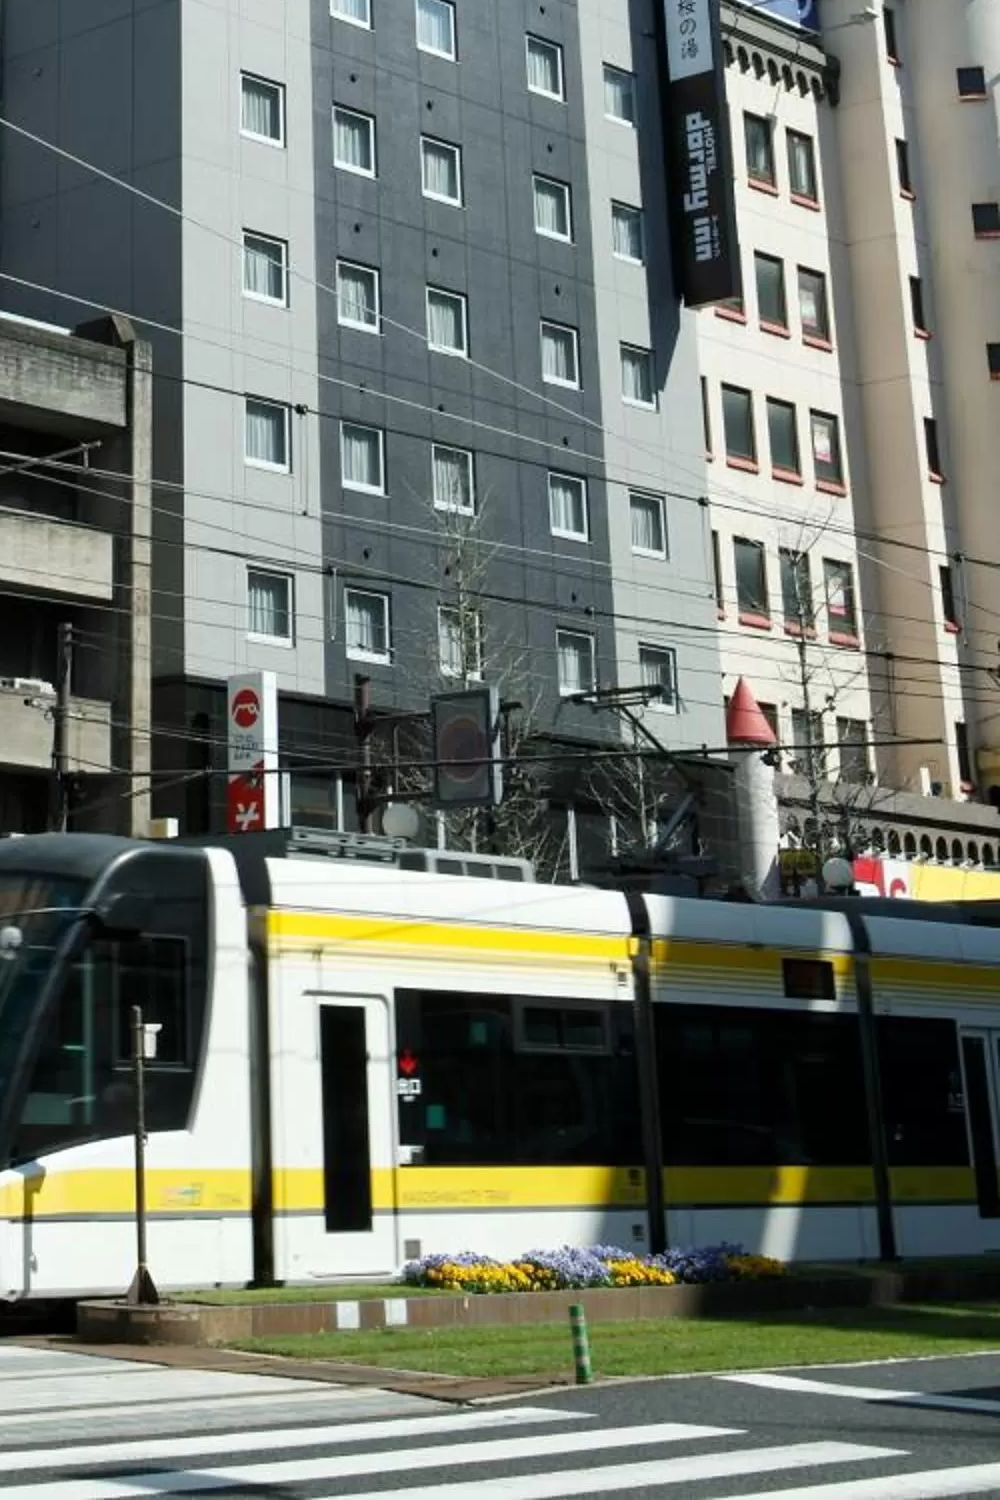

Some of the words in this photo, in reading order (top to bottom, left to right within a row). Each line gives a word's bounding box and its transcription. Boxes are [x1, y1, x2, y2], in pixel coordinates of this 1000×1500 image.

[684, 111, 710, 213] dormy
[704, 127, 718, 176] HOTEL
[694, 215, 713, 262] inn
